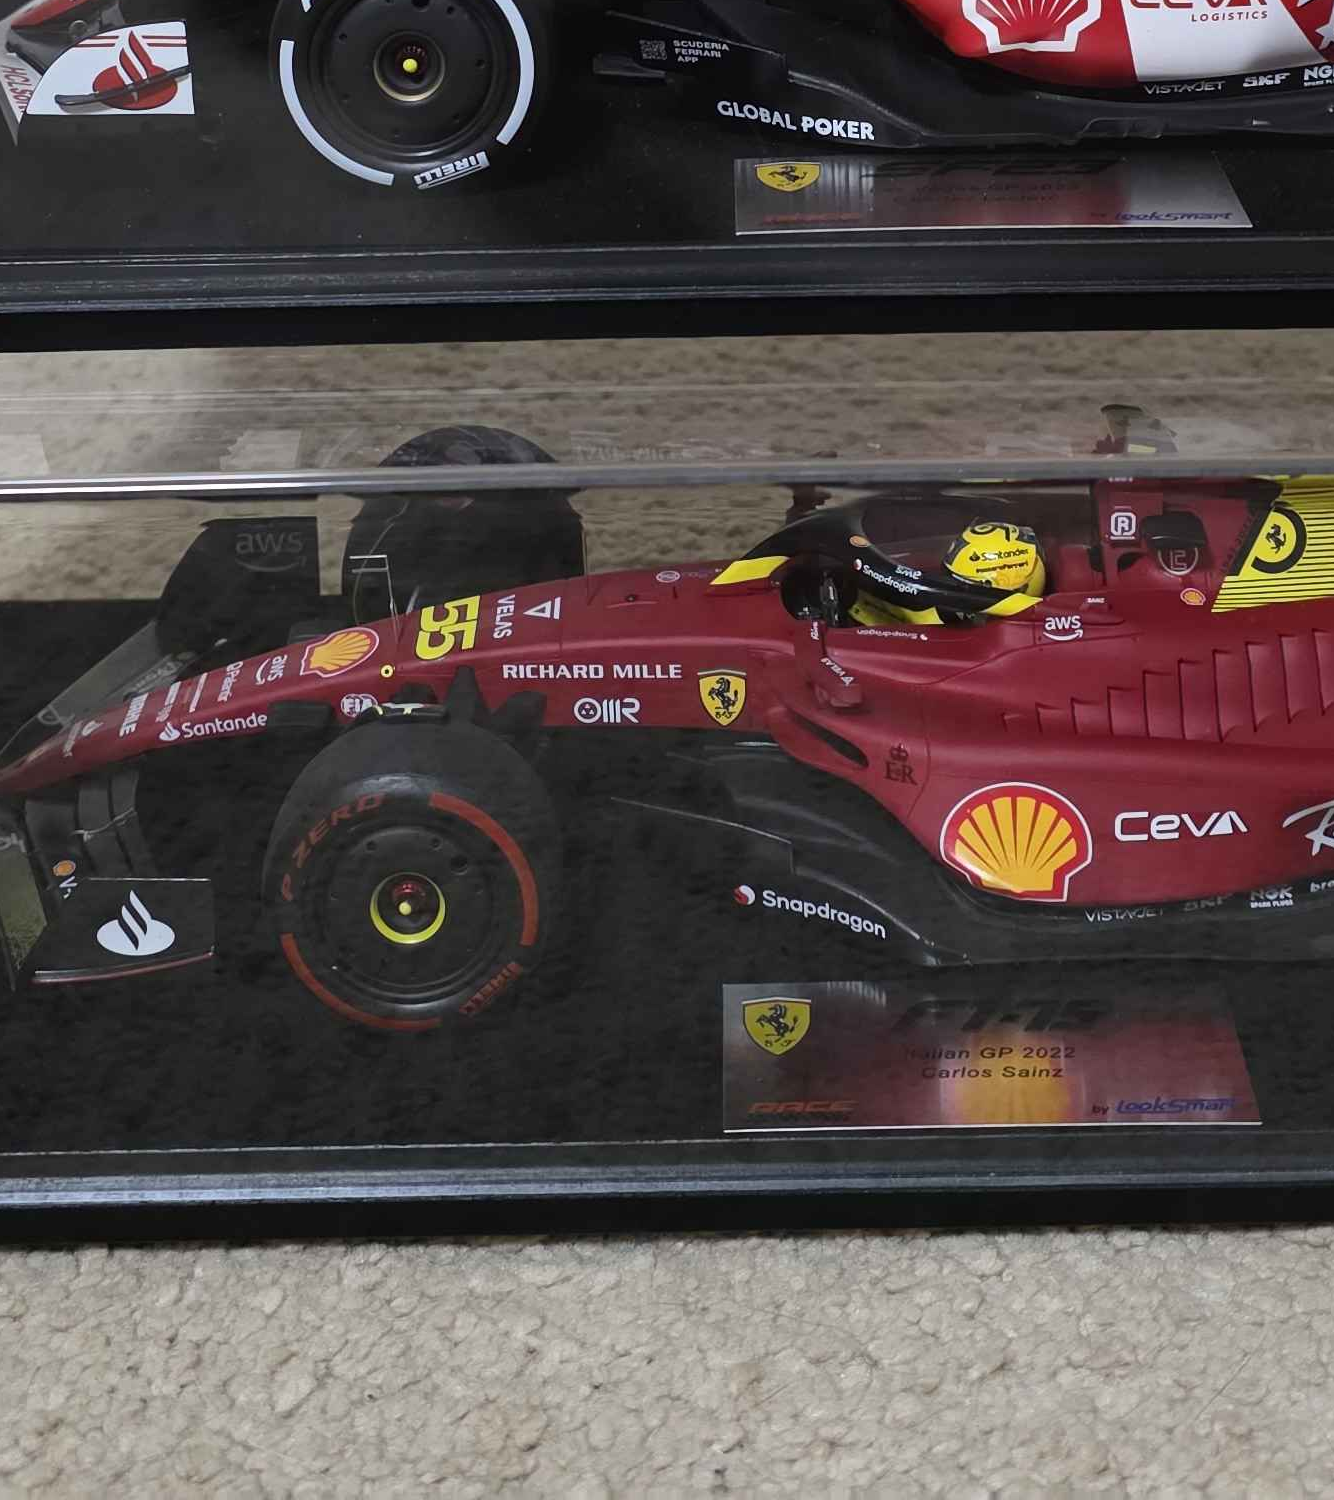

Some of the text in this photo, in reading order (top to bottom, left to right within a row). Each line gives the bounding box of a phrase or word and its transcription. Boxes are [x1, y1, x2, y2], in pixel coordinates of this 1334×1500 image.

[1190, 10, 1269, 23] LOGISTICS
[672, 39, 731, 52] SCUDERIA
[673, 47, 723, 59] FERRARI
[676, 55, 700, 64] APP
[1144, 80, 1227, 95] VISTAJET
[717, 99, 876, 141] GLOBAL POKER
[235, 530, 305, 554] aws
[861, 563, 919, 596] Snapdragon
[415, 594, 482, 661] 55
[1044, 615, 1083, 631] aws
[502, 663, 683, 681] RICHARD MILLE
[181, 712, 268, 740] Santande
[762, 890, 887, 939] Snapdragon
[979, 1046, 1014, 1060] GP
[1022, 1046, 1076, 1059] 2022
[921, 1066, 1064, 1079] Carlos Sainz
